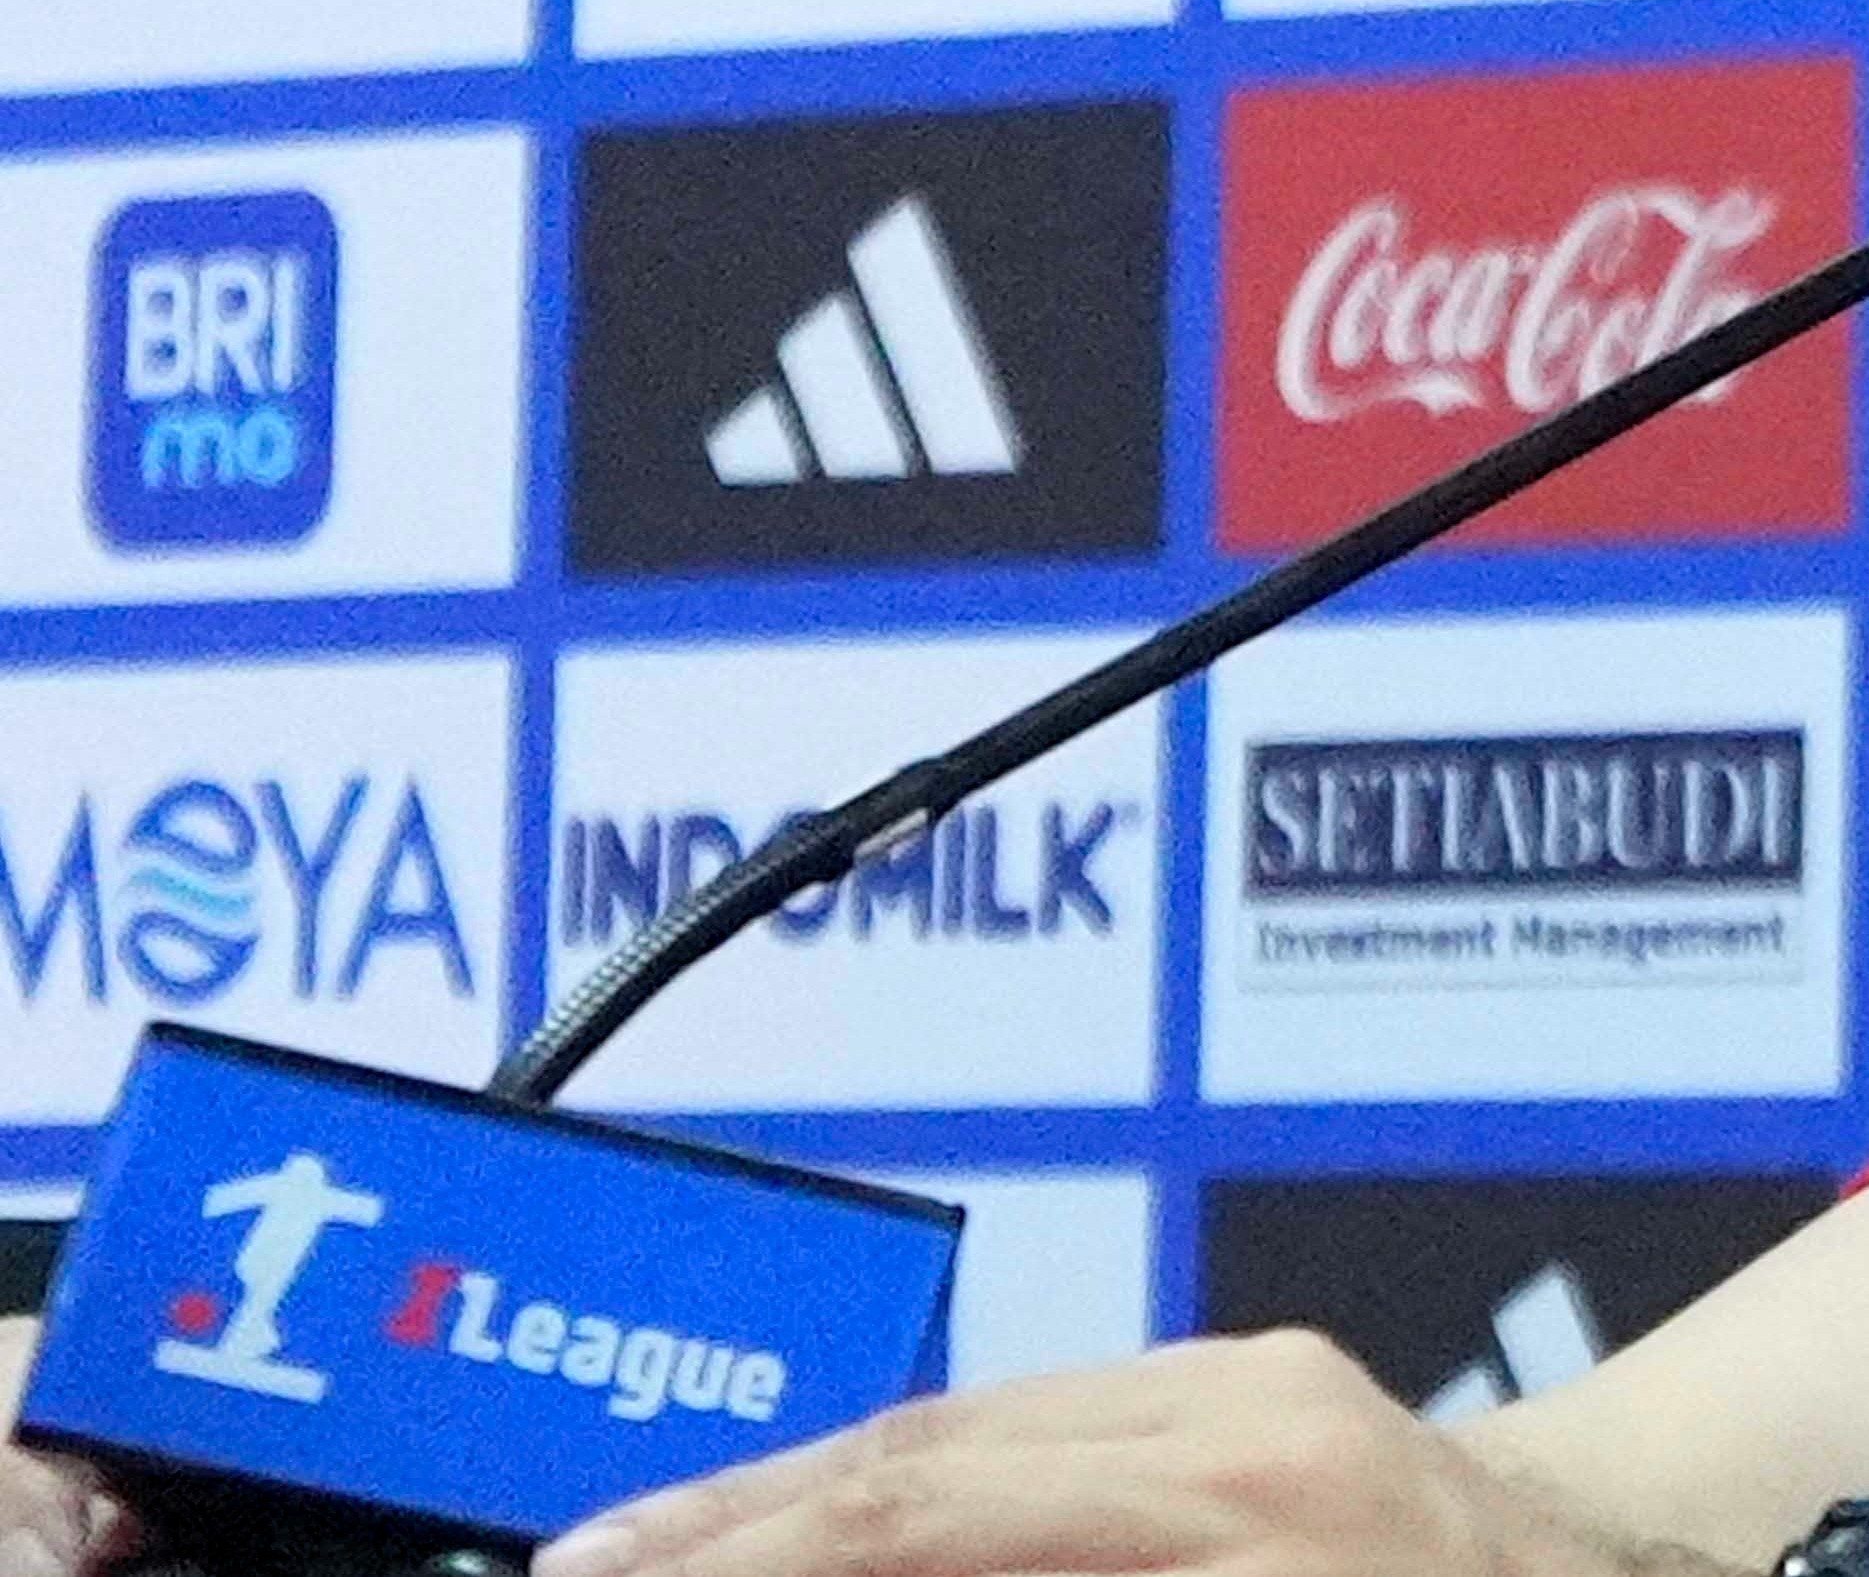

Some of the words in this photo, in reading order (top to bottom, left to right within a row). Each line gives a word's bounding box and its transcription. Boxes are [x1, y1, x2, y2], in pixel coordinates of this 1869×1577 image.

[122, 254, 305, 403] BRI
[140, 401, 296, 489] mo
[1257, 755, 1785, 878] SETIABUDI
[1257, 921, 1497, 964] Investment
[1511, 916, 1787, 965] Management
